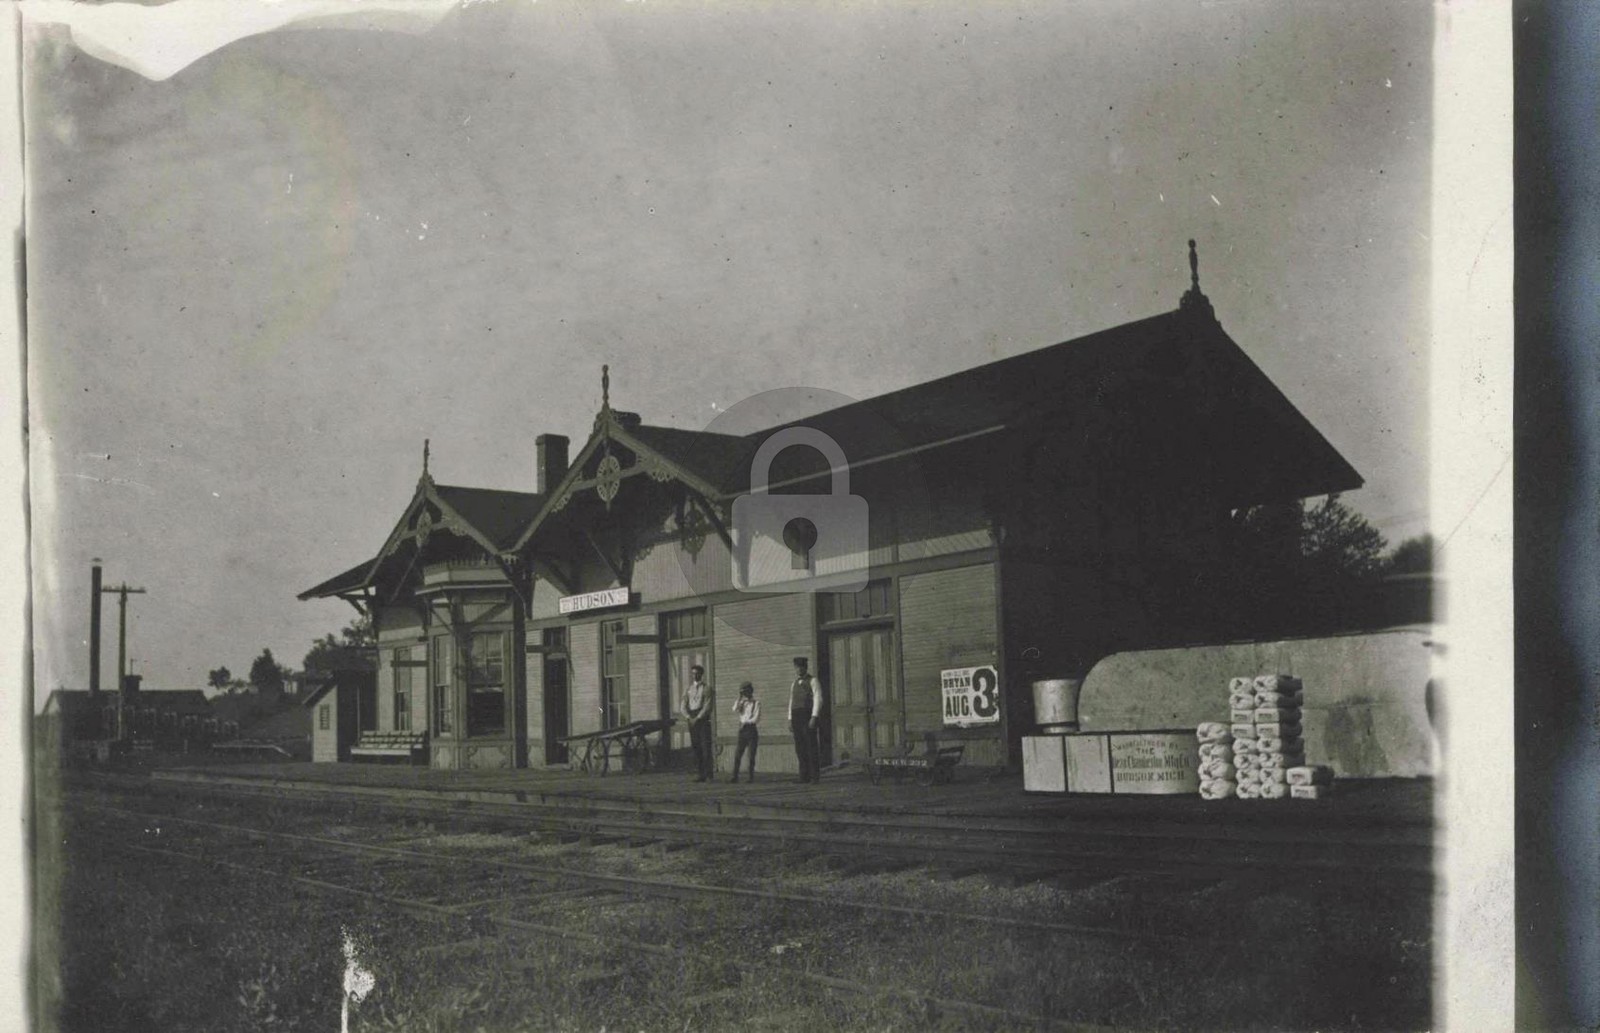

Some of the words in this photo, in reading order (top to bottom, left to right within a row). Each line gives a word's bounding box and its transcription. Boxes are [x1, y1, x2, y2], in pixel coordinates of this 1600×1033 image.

[573, 591, 614, 611] HUDSON
[943, 676, 971, 688] BRYAN
[972, 668, 998, 717] 3
[1136, 747, 1155, 755] THE
[1117, 771, 1154, 782] HUDSON
